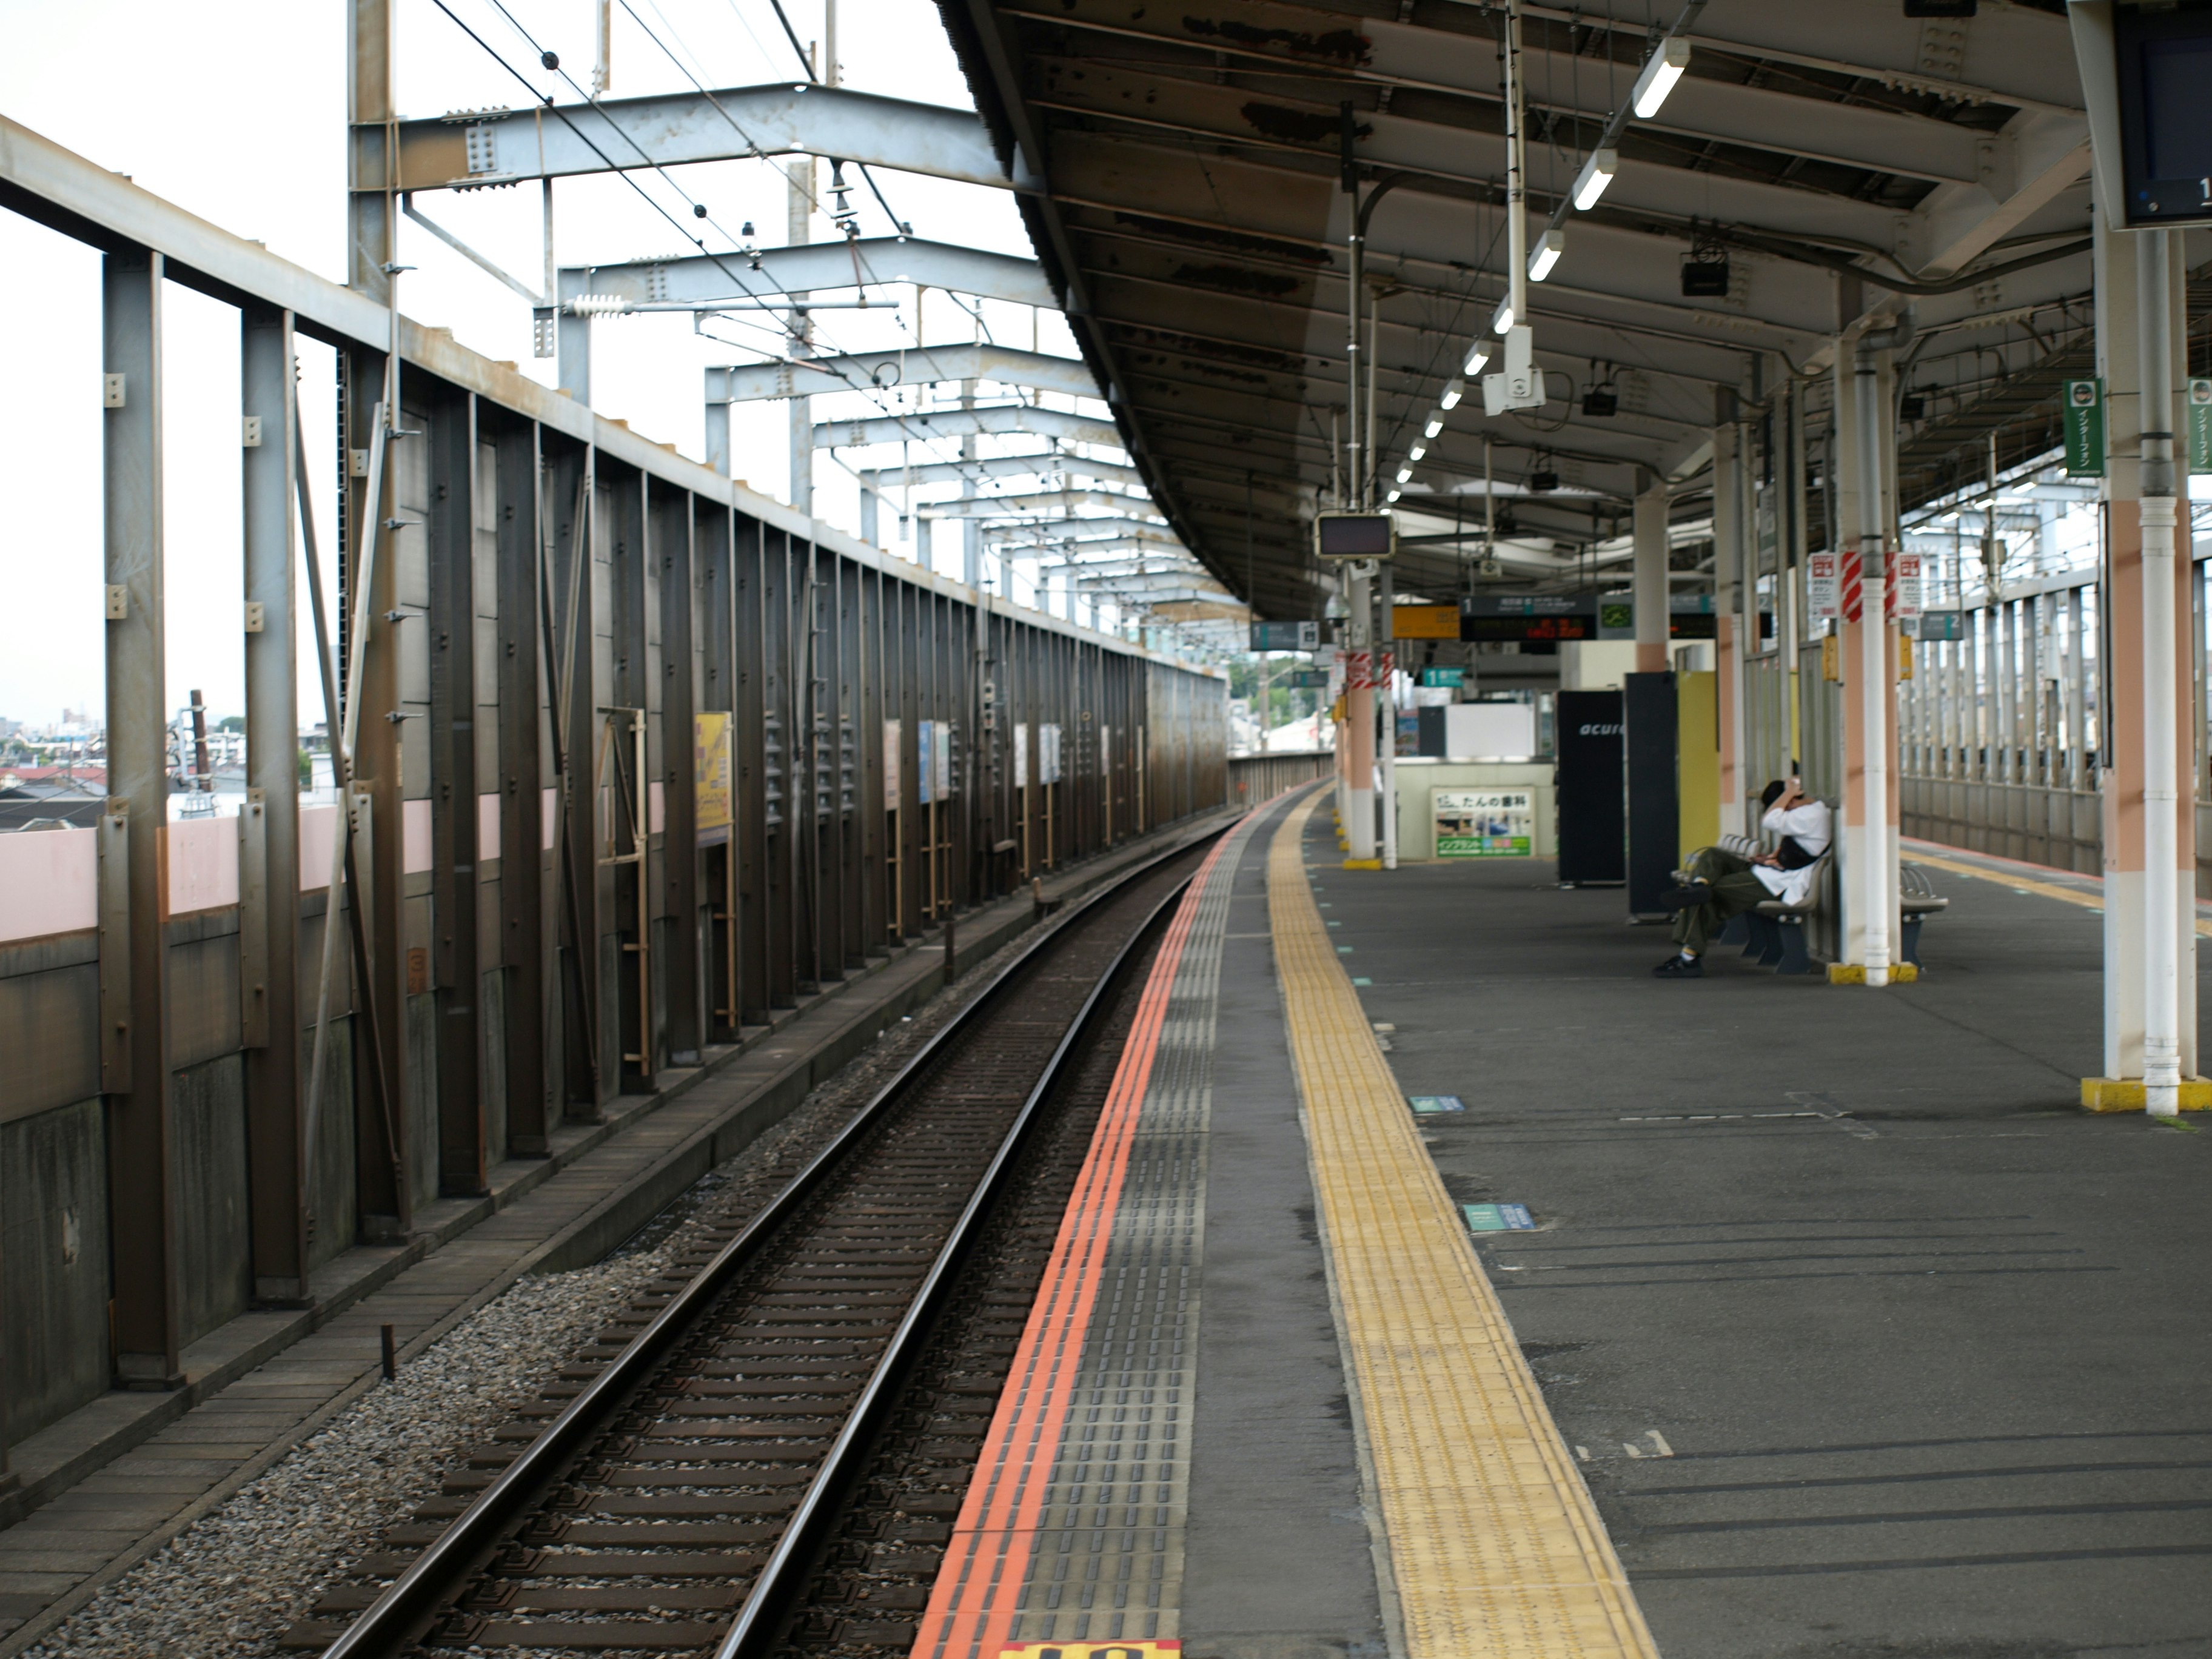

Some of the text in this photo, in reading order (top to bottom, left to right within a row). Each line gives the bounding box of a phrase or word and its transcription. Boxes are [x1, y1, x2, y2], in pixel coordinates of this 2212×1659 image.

[2200, 178, 2210, 199] 1
[2079, 409, 2090, 467] インターフォン
[2197, 407, 2208, 465] インターフォン
[1951, 615, 1960, 628] 2
[1429, 670, 1436, 686] 1
[1463, 795, 1526, 808] たんの歯科
